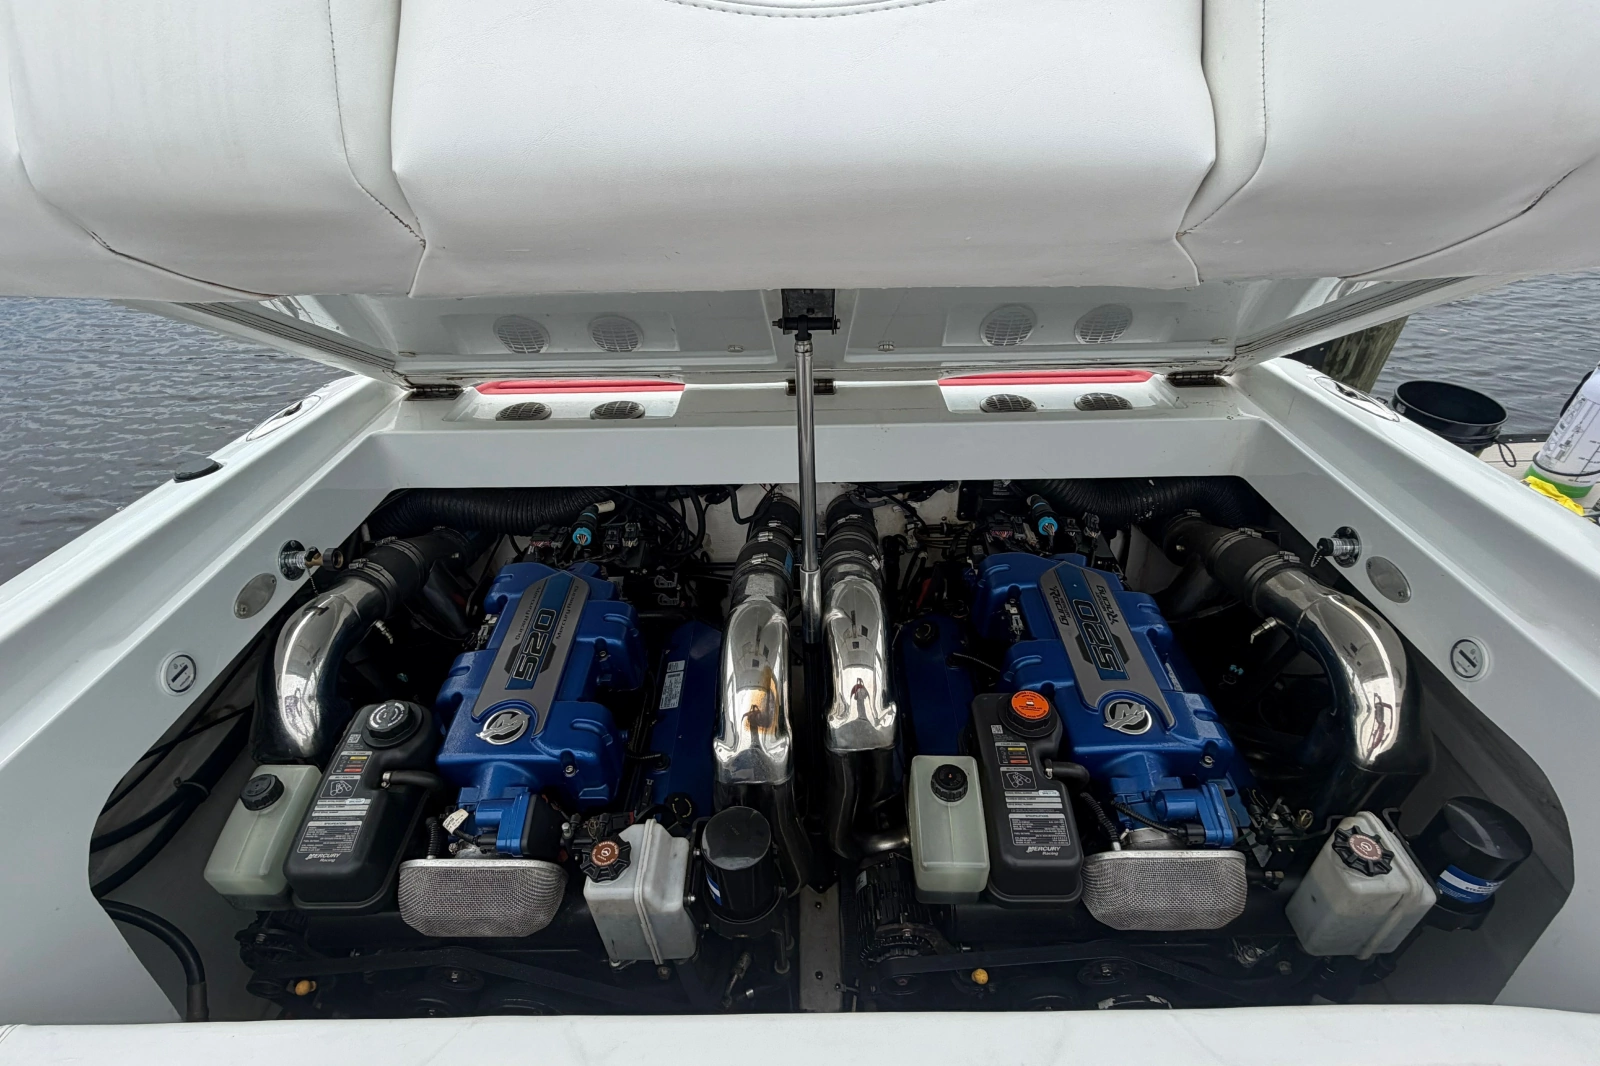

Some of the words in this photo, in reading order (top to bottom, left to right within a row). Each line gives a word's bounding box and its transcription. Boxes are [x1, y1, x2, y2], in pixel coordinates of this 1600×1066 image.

[555, 608, 572, 640] Mercury
[1049, 586, 1070, 626] Racing
[1096, 585, 1119, 625] Racing
[513, 608, 557, 682] 520
[1072, 599, 1124, 672] 520
